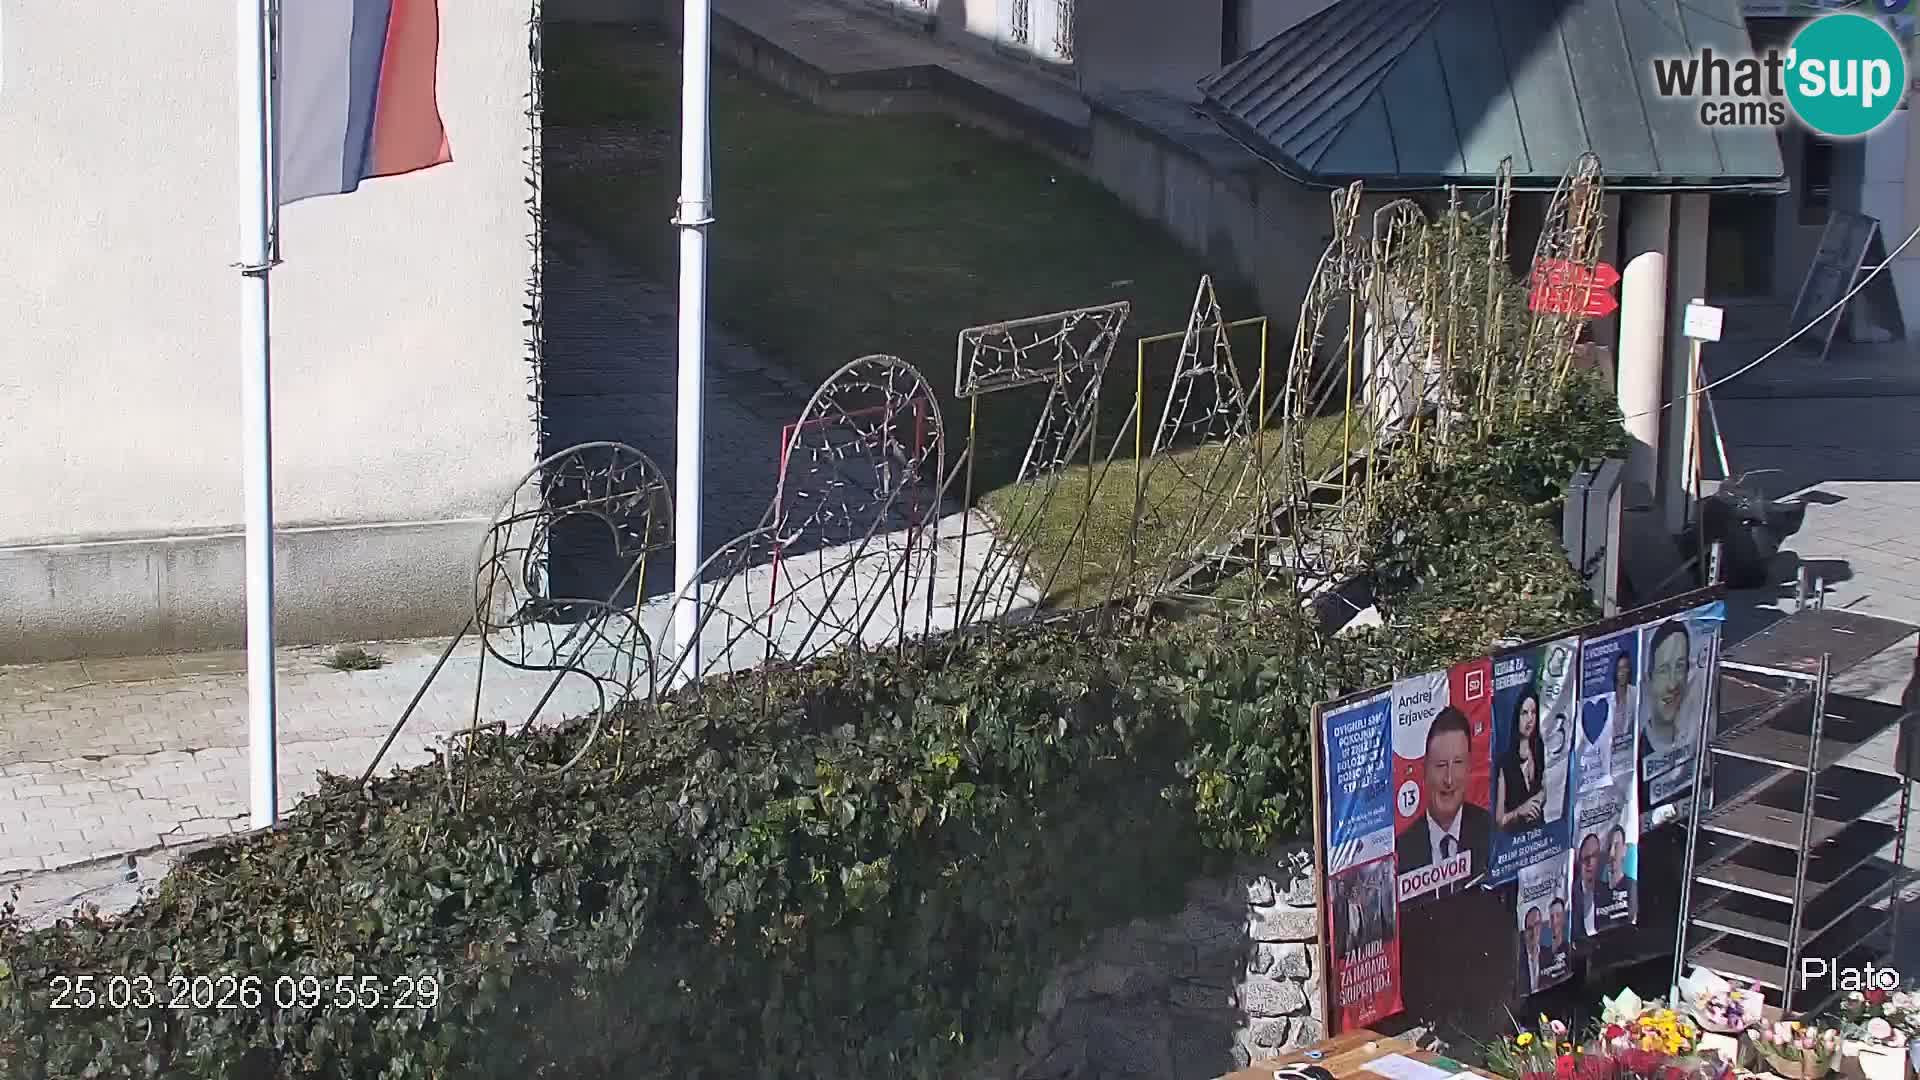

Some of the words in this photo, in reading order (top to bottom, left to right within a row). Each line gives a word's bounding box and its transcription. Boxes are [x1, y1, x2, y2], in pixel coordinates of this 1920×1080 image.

[1398, 687, 1432, 708] Andrej
[1398, 708, 1436, 726] Erjavec
[1402, 790, 1416, 808] 13
[1402, 858, 1467, 895] DOGOVOR
[1345, 948, 1357, 968] ZA
[1340, 968, 1353, 989] ZA
